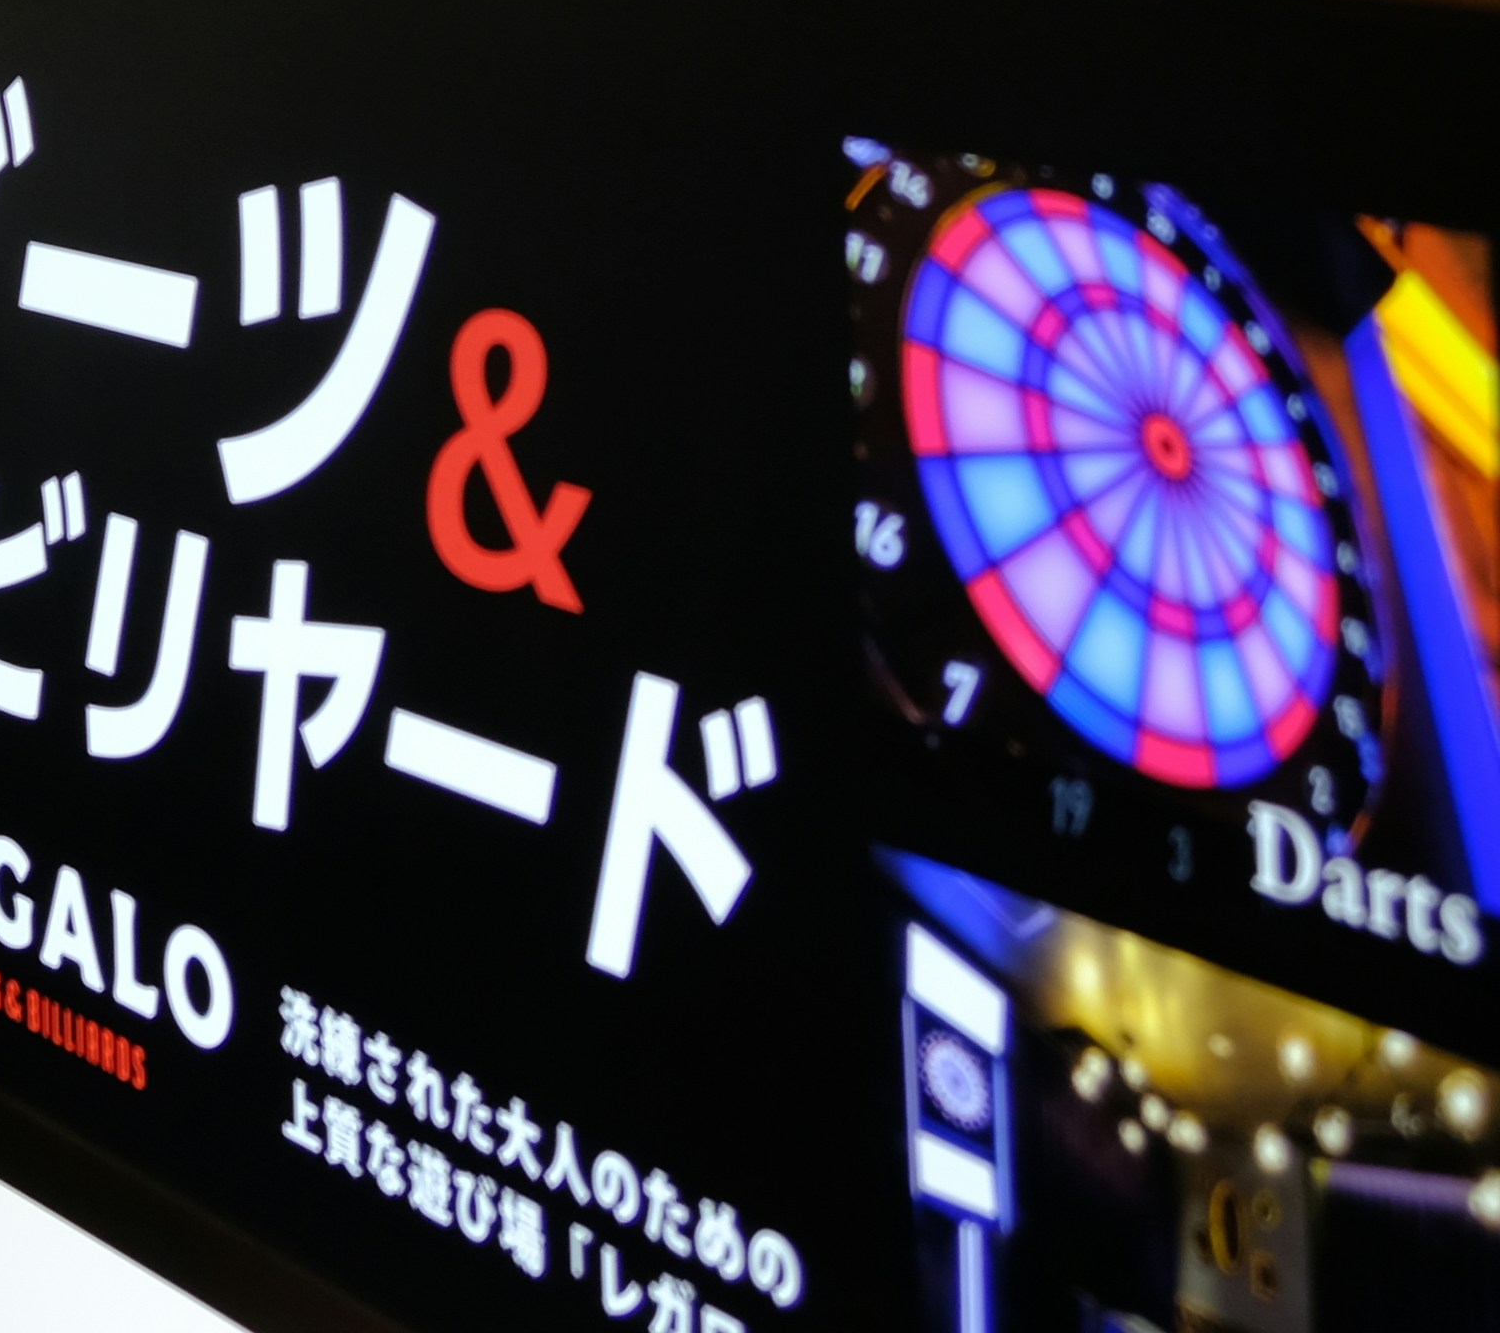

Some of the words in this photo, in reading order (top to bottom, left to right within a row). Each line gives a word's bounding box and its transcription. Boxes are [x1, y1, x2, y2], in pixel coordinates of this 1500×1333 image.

[425, 306, 593, 615] &
[1247, 798, 1484, 968] Darts
[278, 984, 804, 1309] 洗練された大人のための
